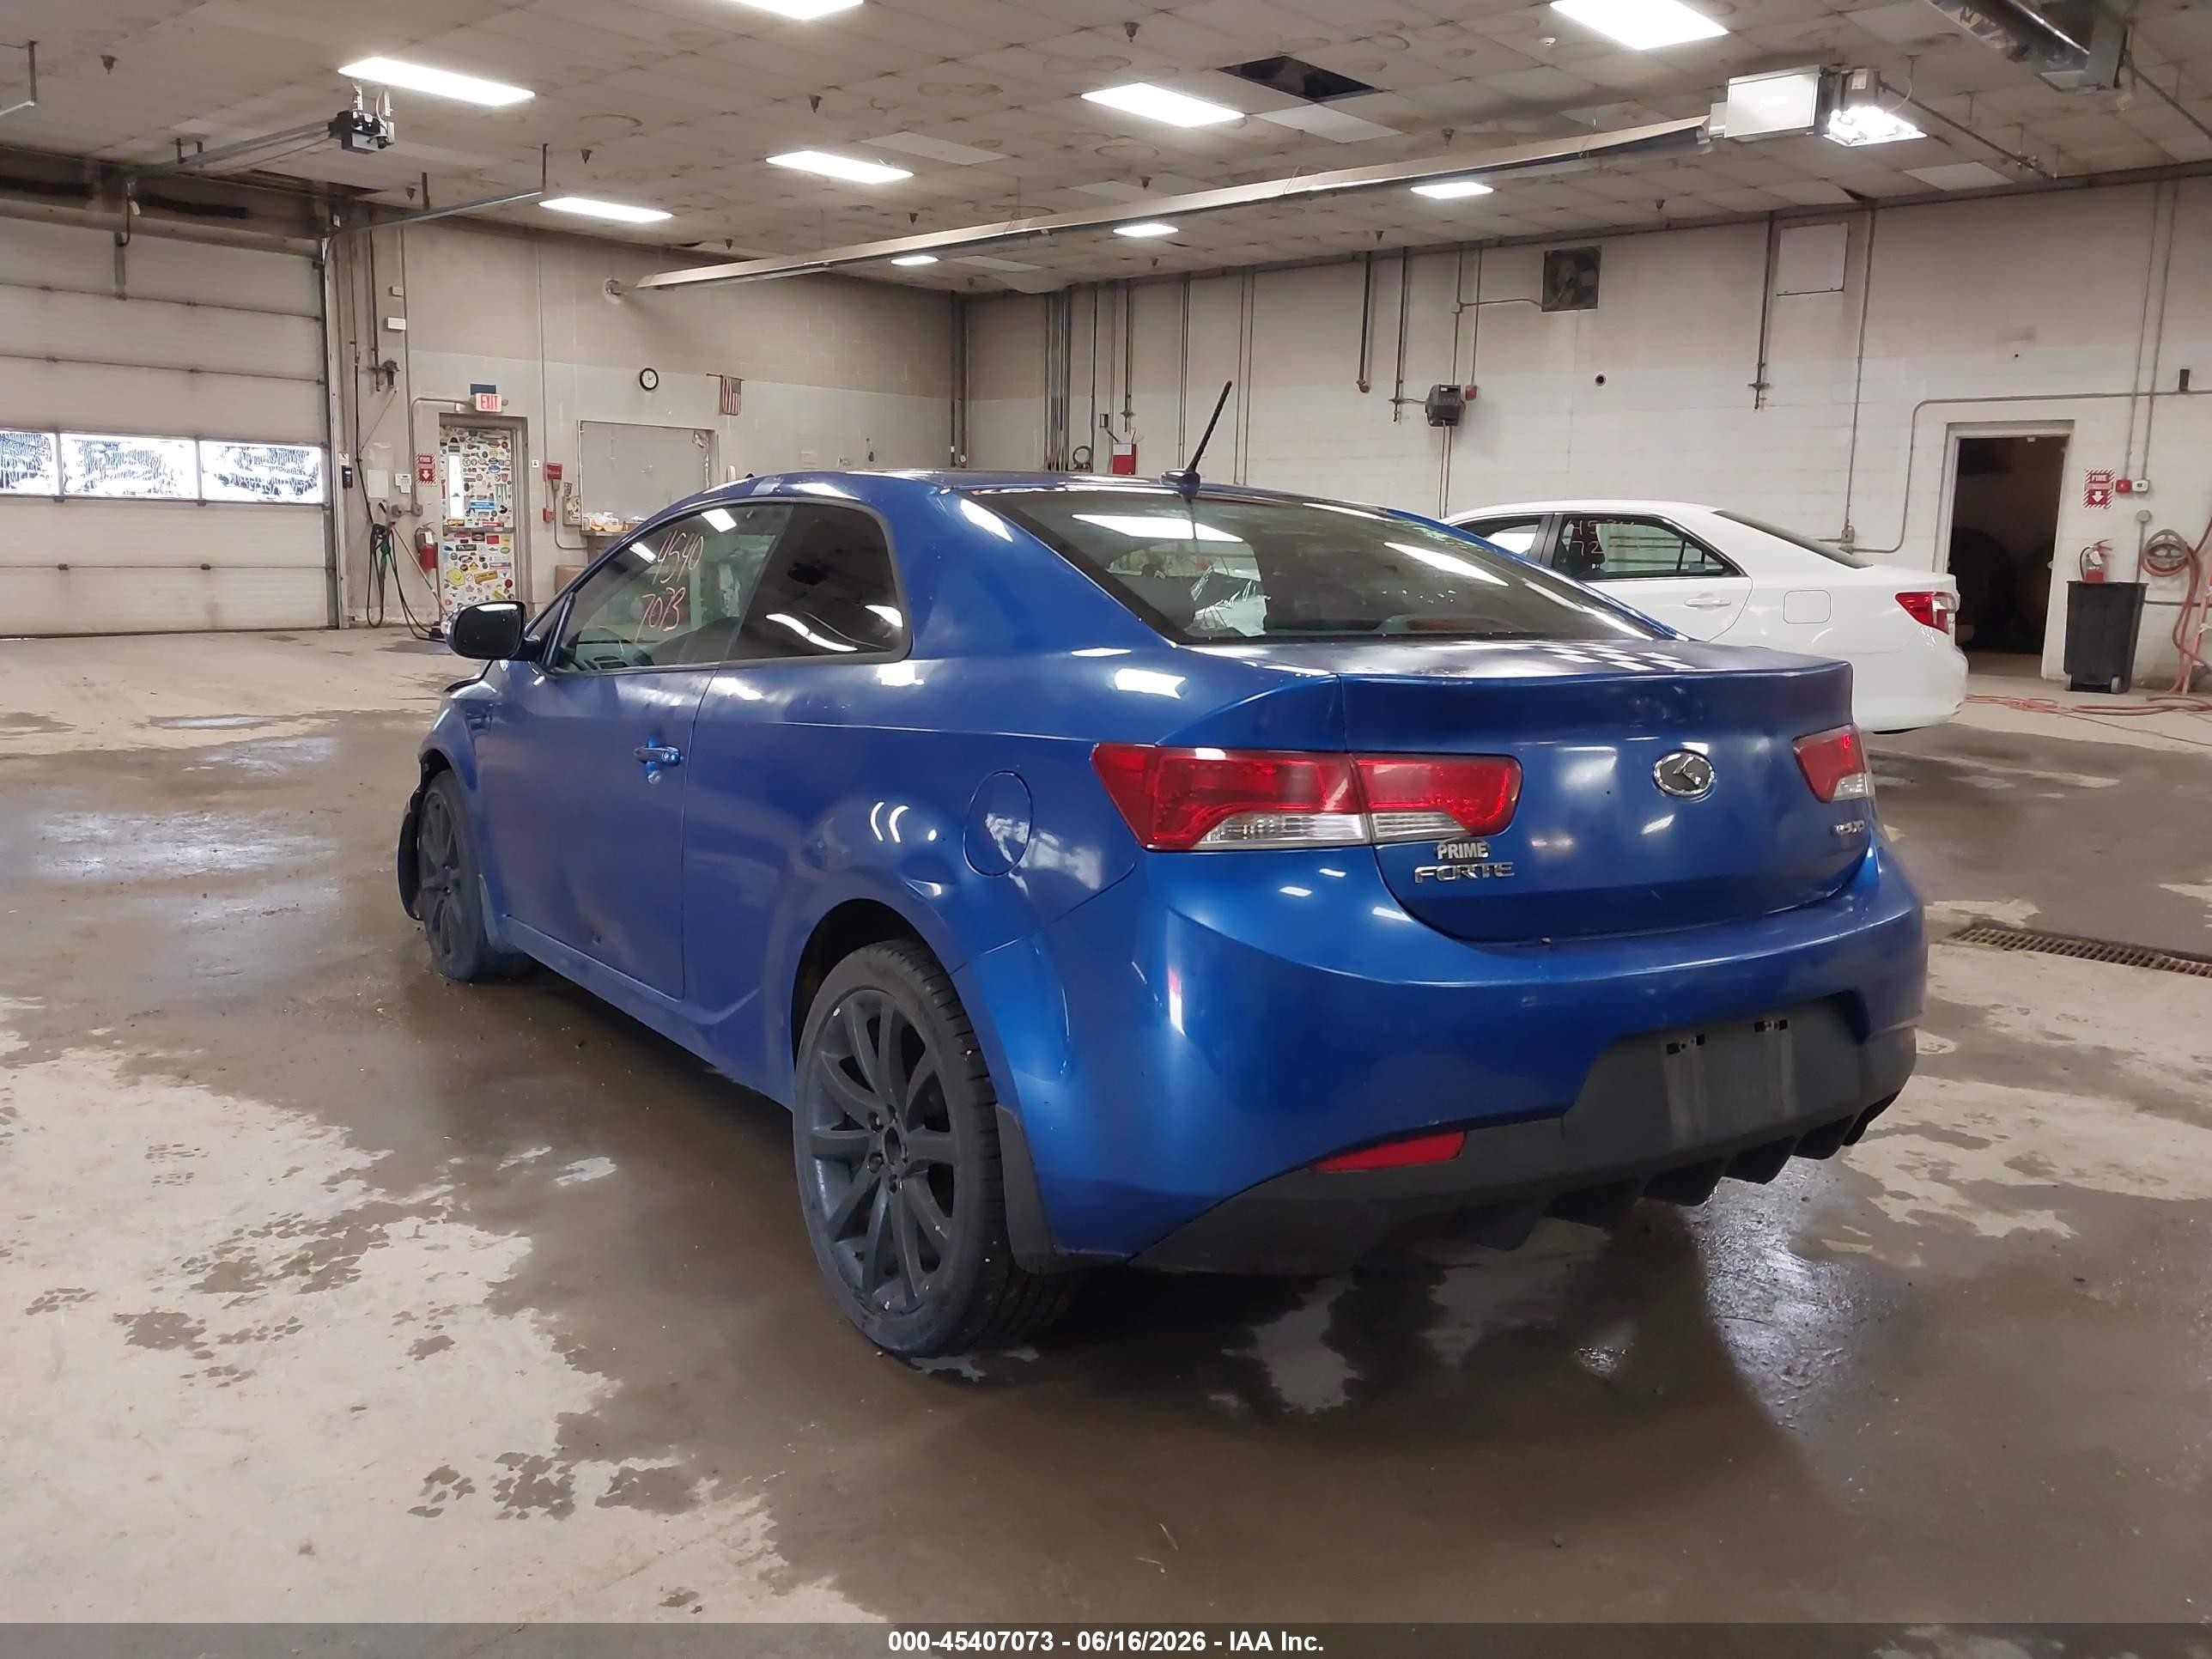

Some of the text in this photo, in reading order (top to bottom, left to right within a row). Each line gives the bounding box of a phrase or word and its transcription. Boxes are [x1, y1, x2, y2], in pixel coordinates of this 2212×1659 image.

[480, 394, 499, 410] EXIT
[653, 530, 704, 585] 4540
[1437, 842, 1489, 860] PRIME
[1414, 861, 1516, 884] FORTE
